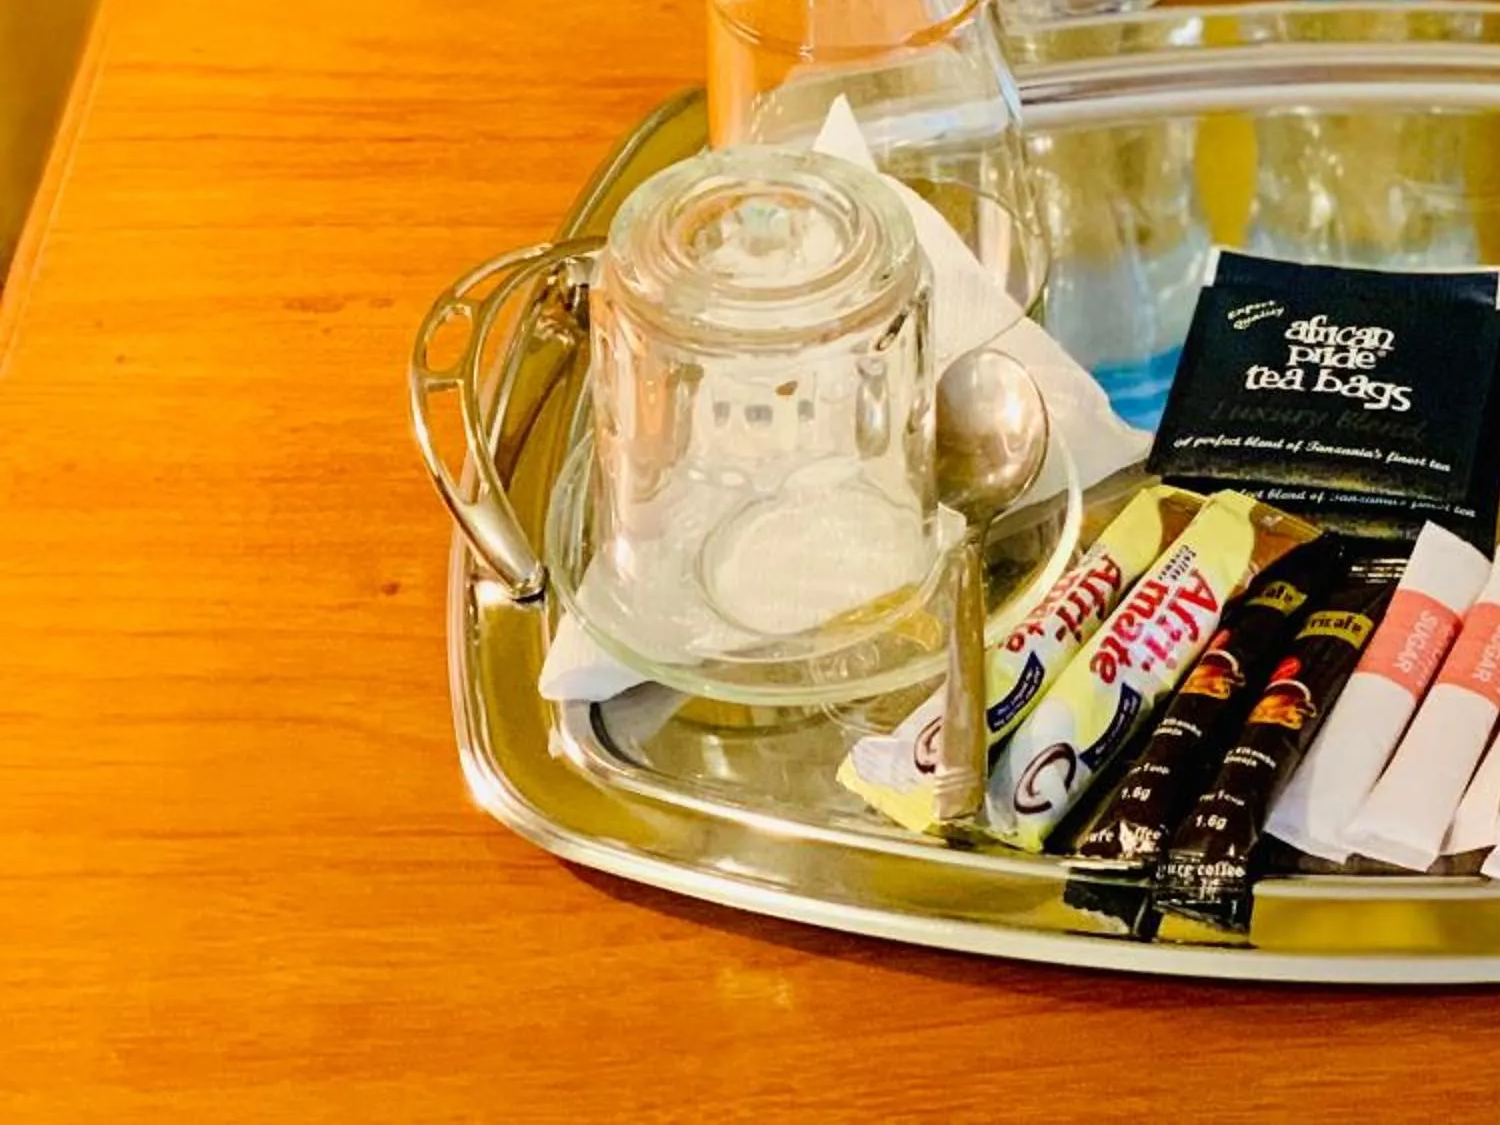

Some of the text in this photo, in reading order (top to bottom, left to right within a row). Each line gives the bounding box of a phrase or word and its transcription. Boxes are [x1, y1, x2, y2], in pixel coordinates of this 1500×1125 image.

[1284, 315, 1396, 350] african
[1286, 344, 1377, 370] pride
[1245, 364, 1413, 412] tea bags
[1194, 434, 1241, 449] perfect
[1244, 435, 1283, 449] blend
[1286, 440, 1304, 453] of
[1429, 458, 1451, 473] tea
[1267, 488, 1306, 501] blend
[1310, 491, 1325, 504] of
[1090, 579, 1170, 684] mate
[1392, 609, 1439, 673] SUGAR
[1195, 814, 1229, 830] 1.6g
[1197, 861, 1246, 878] coffee
